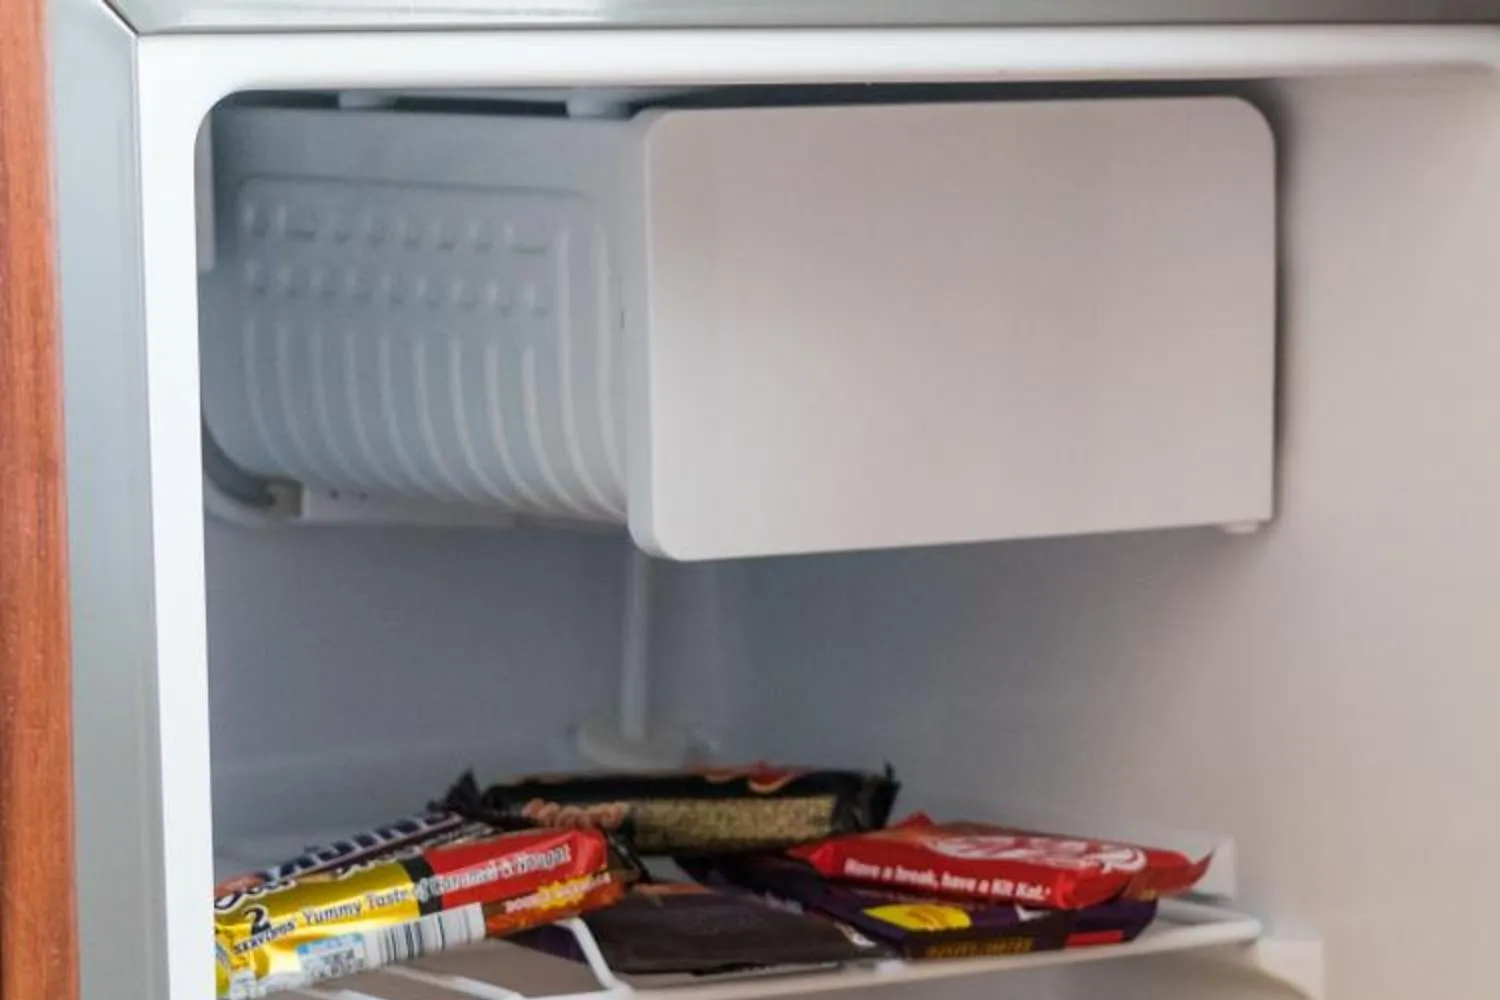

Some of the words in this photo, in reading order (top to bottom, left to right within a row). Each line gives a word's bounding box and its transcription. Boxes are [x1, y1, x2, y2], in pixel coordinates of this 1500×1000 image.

[844, 857, 881, 879] Have
[882, 866, 894, 880] a
[941, 871, 977, 892] have
[978, 879, 990, 894] a
[991, 878, 1014, 896] Kit
[244, 904, 271, 935] 2
[302, 902, 362, 927] Yummy
[366, 888, 410, 911] Taste
